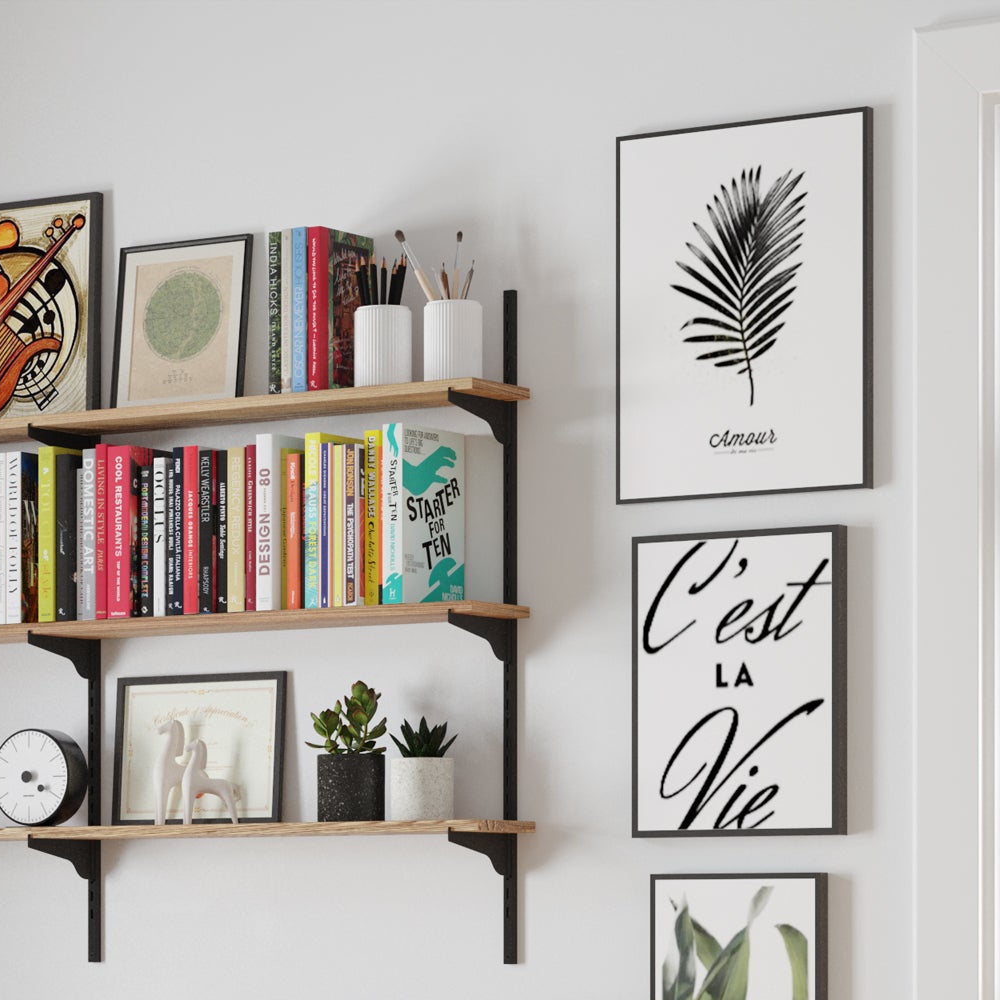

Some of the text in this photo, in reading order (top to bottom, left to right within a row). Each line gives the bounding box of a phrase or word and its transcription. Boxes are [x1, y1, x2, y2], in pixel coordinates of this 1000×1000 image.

[295, 243, 304, 378] OSCAR NIEMEYER HOUSES
[709, 429, 777, 448] Amour
[201, 456, 210, 478] KELLY
[232, 456, 240, 512] REGENCY
[389, 459, 398, 497] STARTER
[83, 458, 93, 542] DOMESTIC
[98, 498, 104, 509] IN
[154, 471, 164, 543] OCULUS
[201, 480, 210, 522] WEARSTLER
[308, 440, 317, 588] NICOLE KRAUSS FOREST DARK
[388, 503, 398, 521] TEN
[407, 478, 460, 521] STARTER
[9, 520, 18, 541] OF
[232, 515, 240, 555] REDUX
[259, 469, 270, 576] DESIGN 80
[428, 518, 445, 538] FOR
[83, 545, 93, 574] ART
[422, 533, 451, 569] TEN
[643, 539, 832, 654] C'est
[716, 662, 754, 687] LA
[660, 698, 824, 829] Vie
